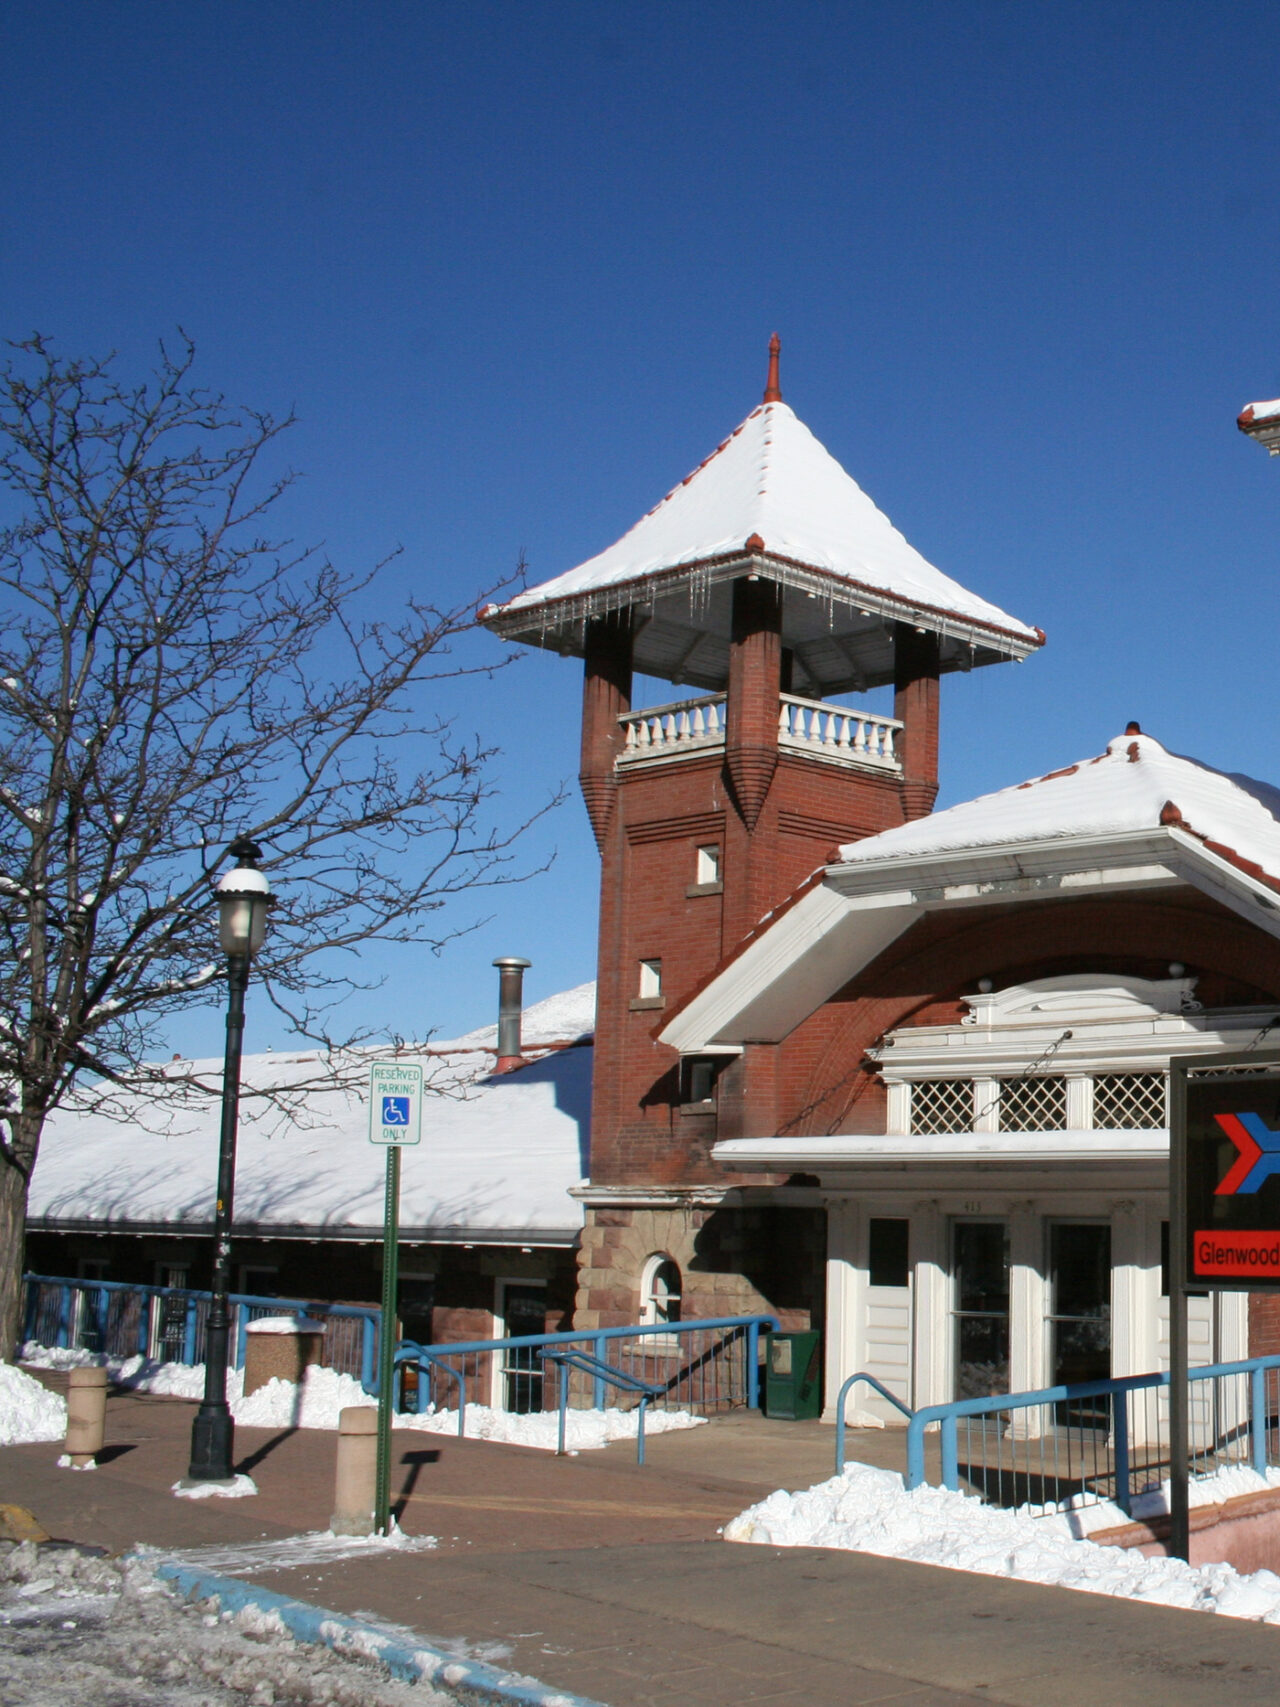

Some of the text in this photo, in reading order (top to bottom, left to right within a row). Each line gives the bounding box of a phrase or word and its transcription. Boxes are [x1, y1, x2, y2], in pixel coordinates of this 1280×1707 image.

[374, 1068, 420, 1081] RESERVED
[377, 1083, 415, 1095] PARKING
[382, 1128, 407, 1139] ONLY
[1199, 1241, 1280, 1267] Glenwood
